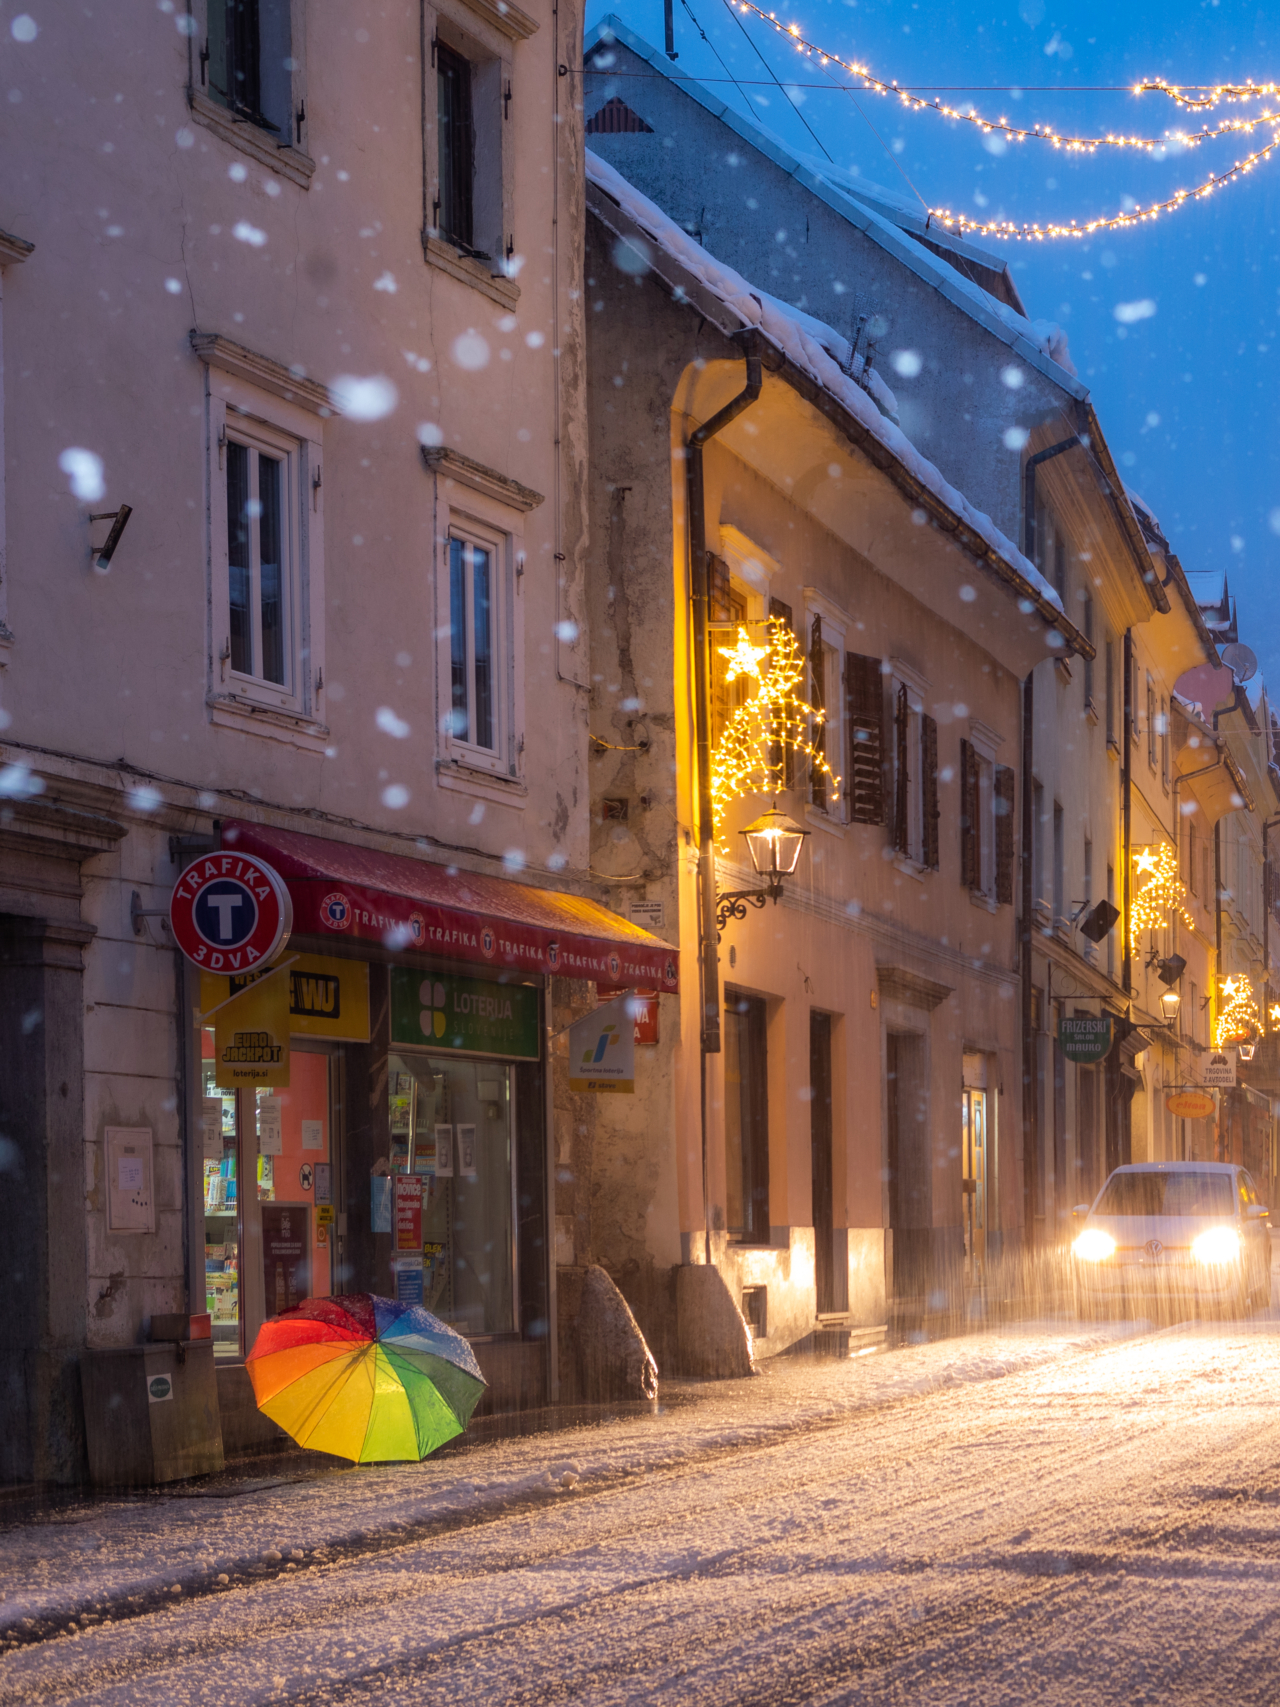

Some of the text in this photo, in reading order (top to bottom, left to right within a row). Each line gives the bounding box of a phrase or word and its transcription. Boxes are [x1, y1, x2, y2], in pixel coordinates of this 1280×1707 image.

[177, 858, 270, 901] TRAFIKA
[322, 894, 349, 908] TRAFIKA
[207, 894, 242, 939] T
[332, 905, 343, 919] T
[354, 908, 405, 934] TRAFIKA
[428, 926, 477, 947] TRAFIKA
[193, 945, 261, 968] 3DVA
[498, 939, 544, 960] TRAFIKA
[562, 952, 606, 971] TRAFIKA
[624, 963, 662, 979] TRAFIKA
[454, 992, 513, 1020] LOTERIJA
[454, 1021, 514, 1041] SLOVENIJE
[1061, 1020, 1107, 1033] FRIZERSKI
[234, 1032, 269, 1047] EURO
[222, 1046, 282, 1063] JACKPOT
[233, 1069, 268, 1079] loterija.si
[397, 1183, 421, 1196] novice
